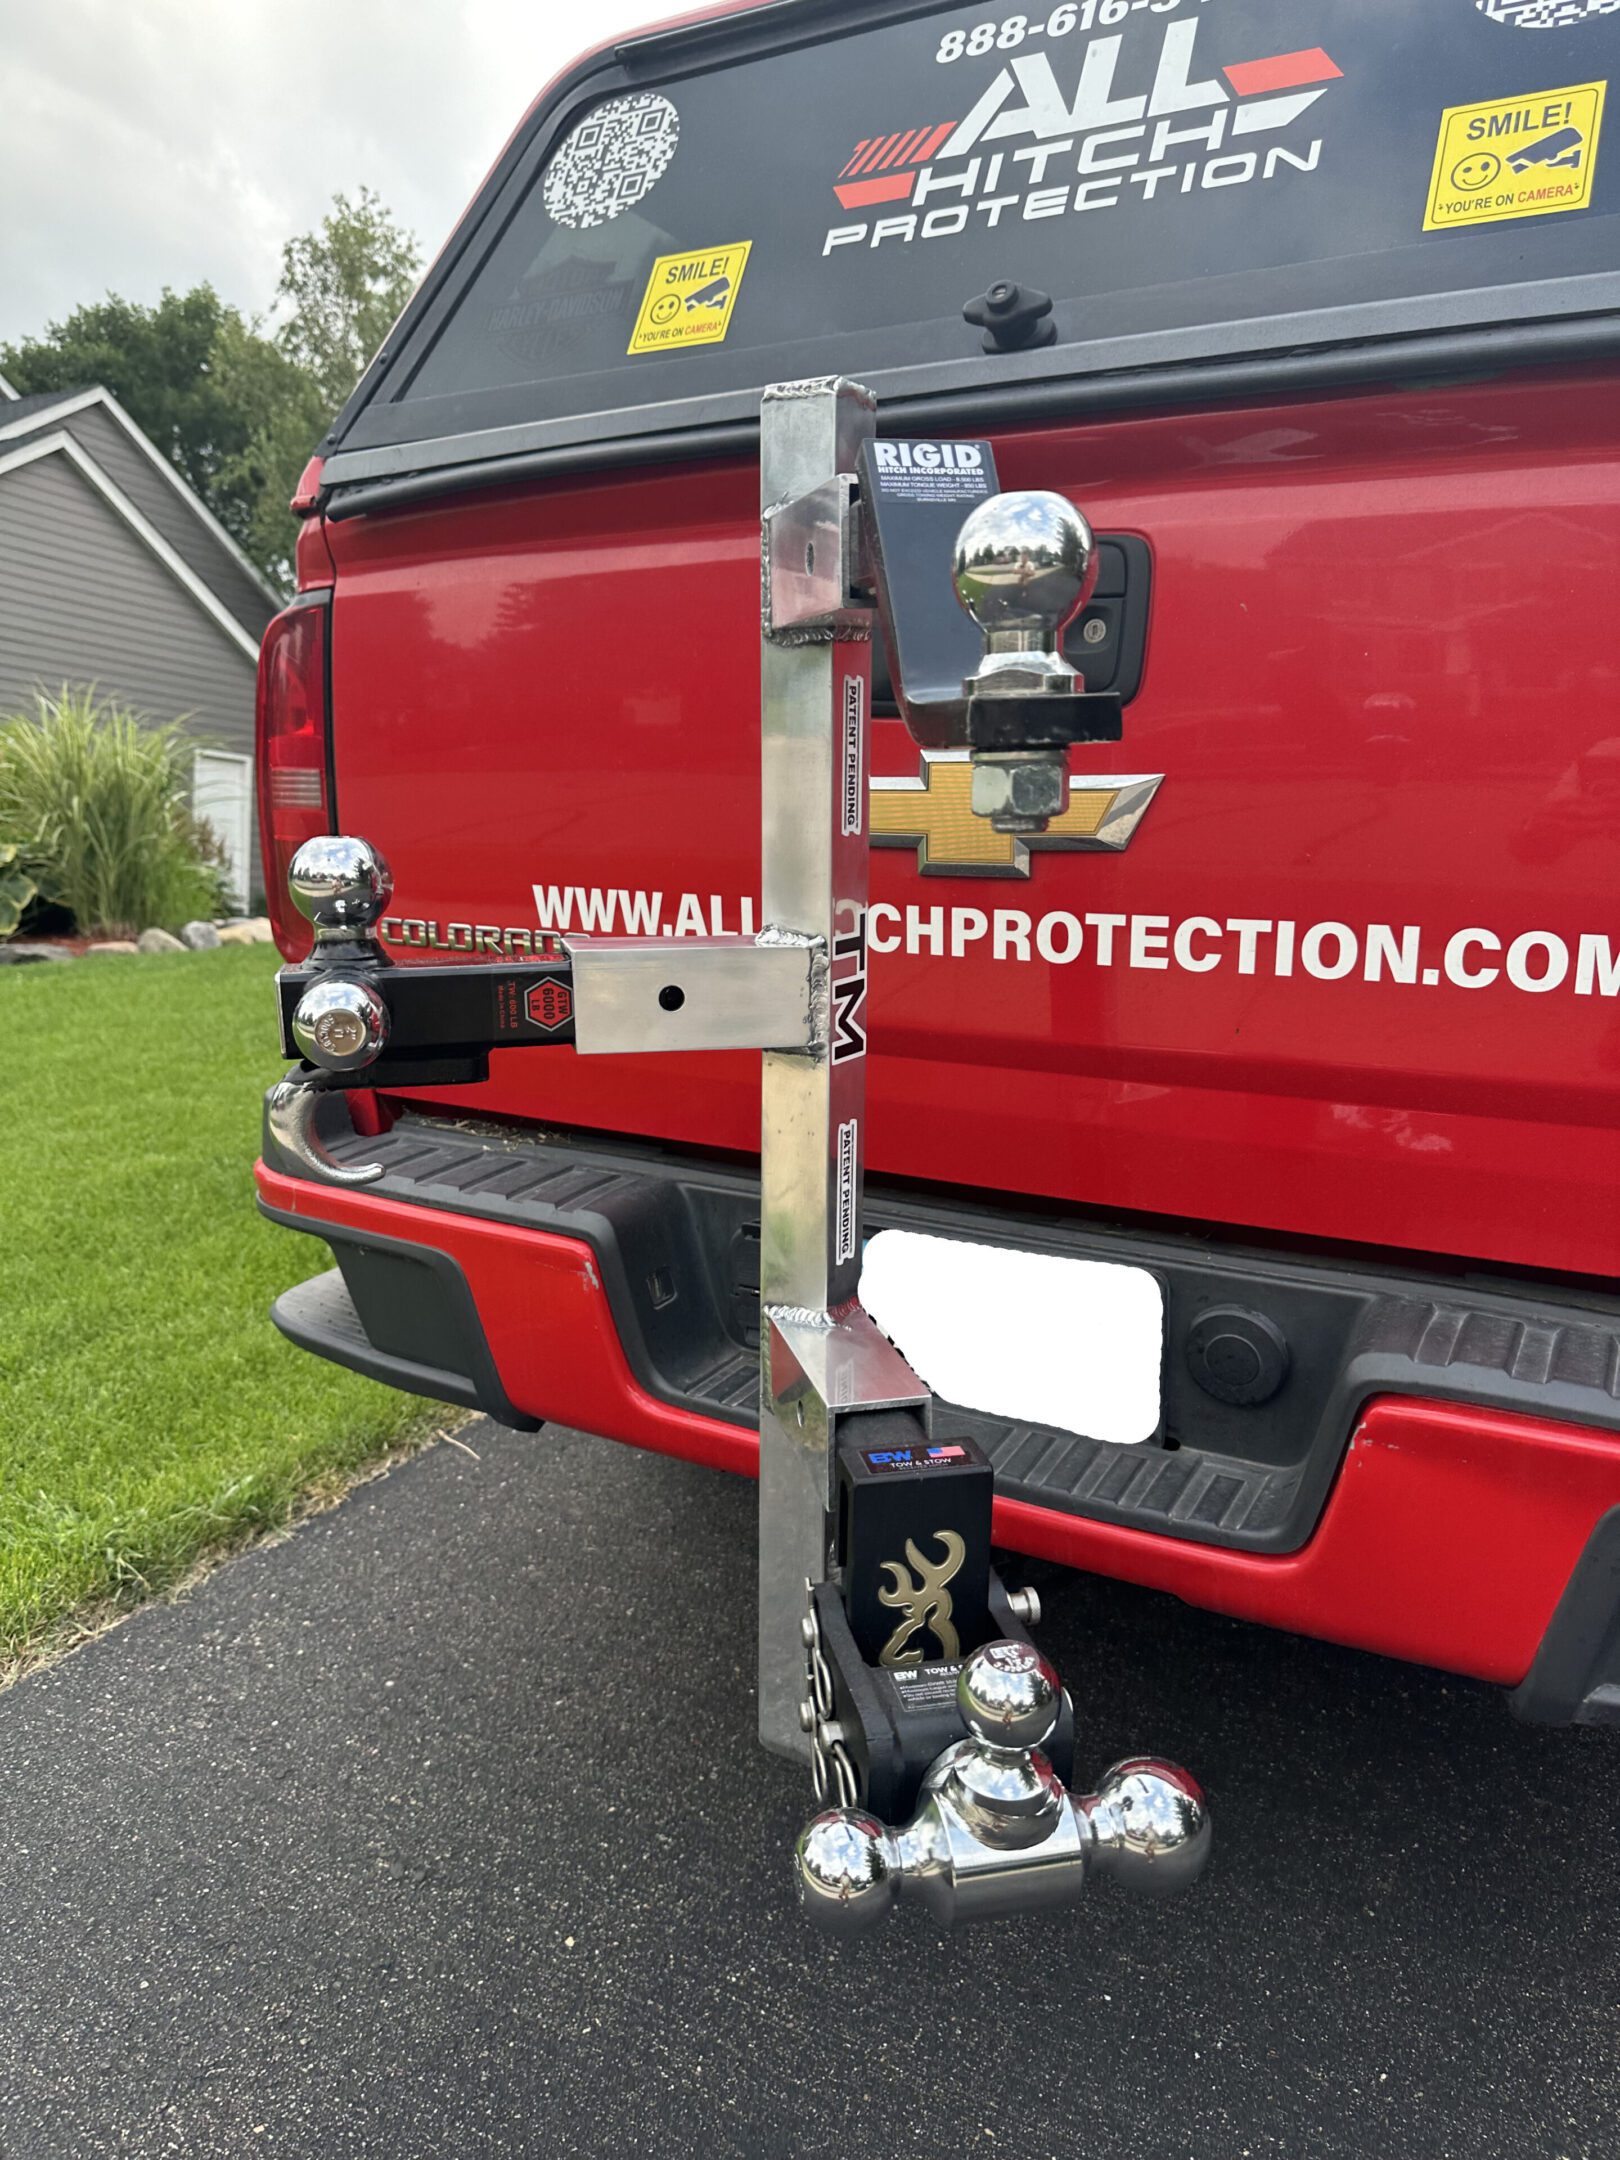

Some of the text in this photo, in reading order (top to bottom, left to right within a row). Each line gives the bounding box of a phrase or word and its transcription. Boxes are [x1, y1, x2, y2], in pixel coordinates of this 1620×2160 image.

[936, 17, 1230, 160] ALL
[1466, 101, 1572, 141] SMILE!
[911, 108, 1228, 207] HITCH
[822, 139, 1323, 256] PROTECTION
[1445, 184, 1573, 214] YOU'RE ON CAMERA
[665, 257, 730, 284] SMILE!
[671, 326, 685, 337] ON
[684, 322, 718, 336] CAMERA
[873, 442, 982, 468] RIGID
[878, 466, 984, 476] HITCH INCORPORATED
[847, 685, 857, 826] PATENT PENDING
[380, 916, 592, 954] COLORAD
[531, 1000, 540, 1011] LB
[542, 987, 556, 1020] 6000
[557, 991, 569, 1015] GTW
[841, 1130, 851, 1255] PATENT PENDING
[890, 1460, 913, 1468] TOW
[924, 1457, 952, 1465] STOW
[924, 1666, 948, 1675] TOW
